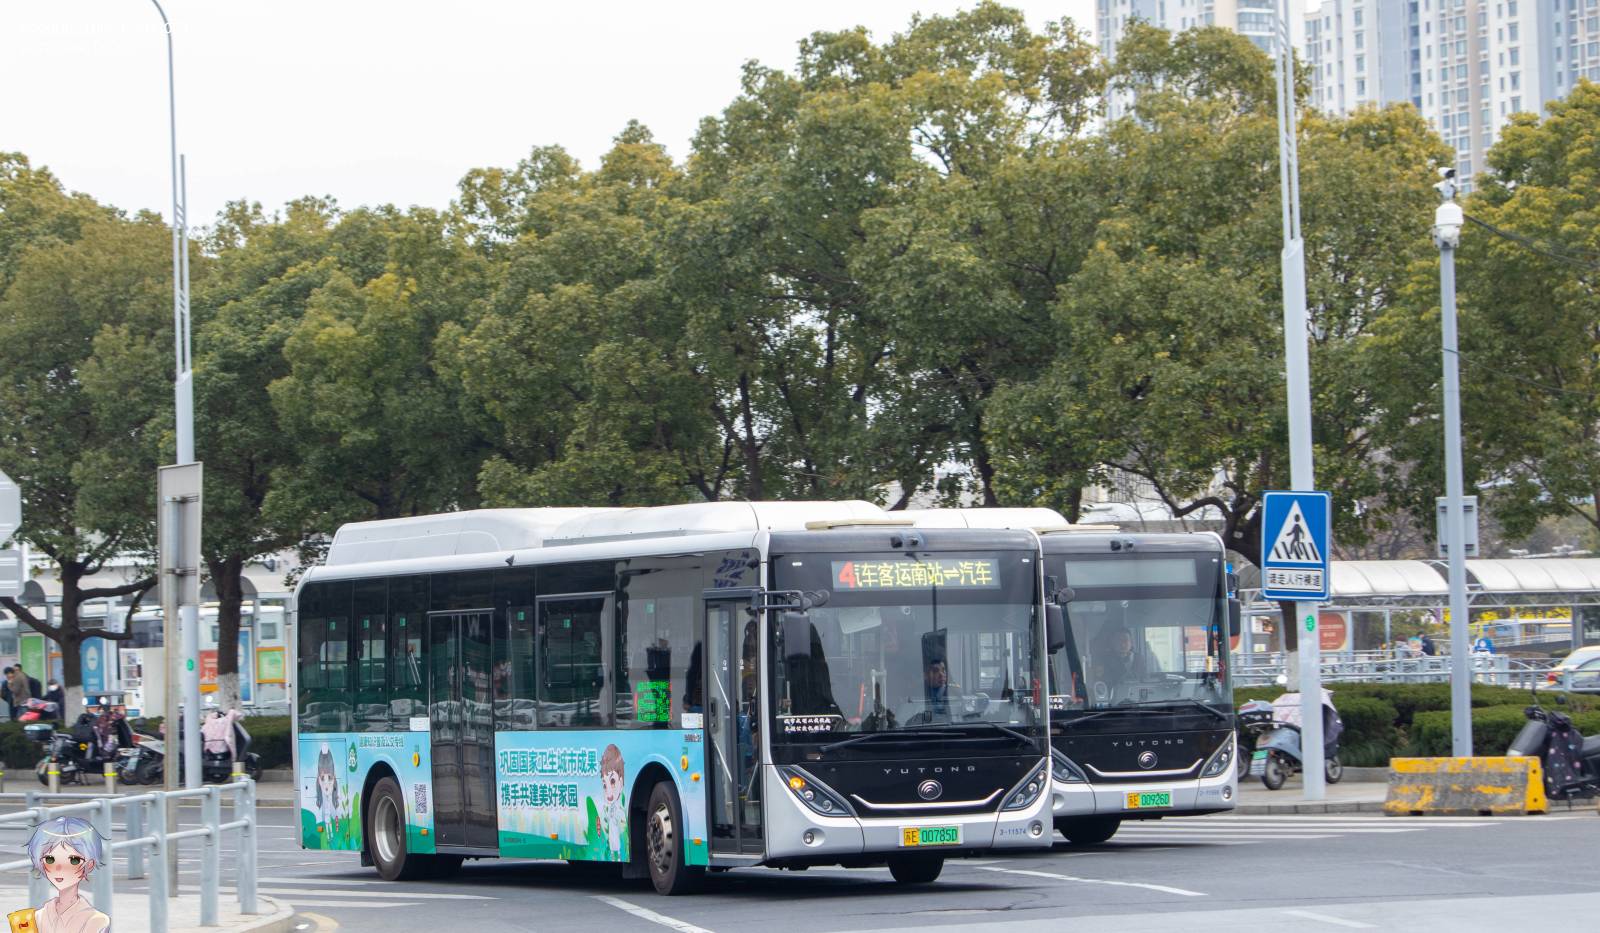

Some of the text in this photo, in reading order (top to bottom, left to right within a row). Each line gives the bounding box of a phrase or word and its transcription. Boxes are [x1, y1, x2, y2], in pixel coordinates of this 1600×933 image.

[839, 560, 855, 588] 4
[959, 561, 992, 585] 汽车
[1268, 573, 1321, 586] 请走人行横道
[1112, 738, 1184, 747] YUTONG
[499, 749, 598, 774] 巩固国家卫生城市成果
[883, 765, 976, 775] YUTONG
[501, 783, 579, 808] 携手共建美好家园
[922, 828, 957, 843] 00785D
